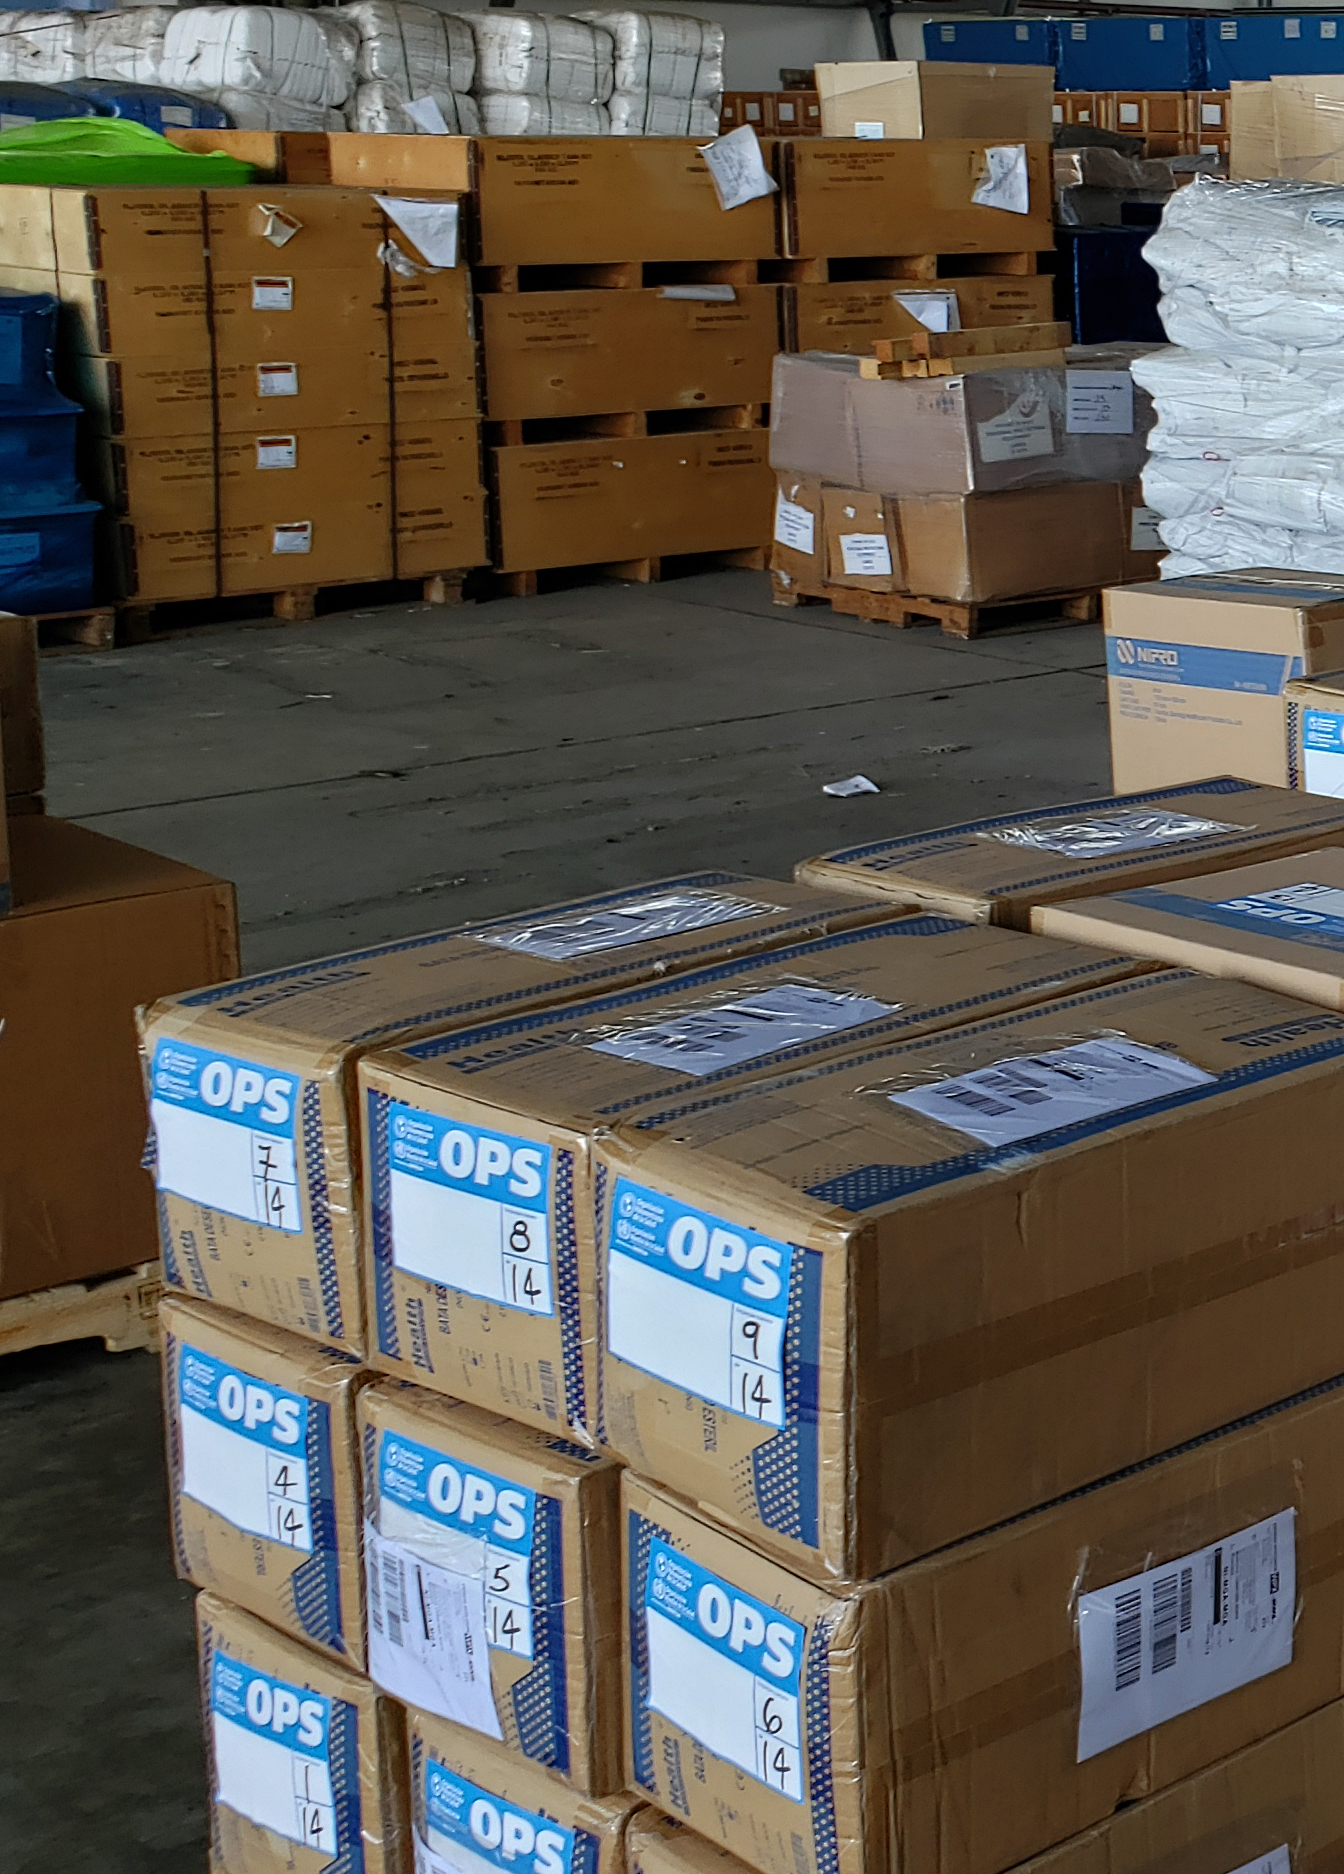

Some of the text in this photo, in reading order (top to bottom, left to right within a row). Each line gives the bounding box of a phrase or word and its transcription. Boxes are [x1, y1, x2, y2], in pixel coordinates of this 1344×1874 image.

[1217, 899, 1327, 925] OPS
[446, 1026, 584, 1072] Healt
[200, 1060, 293, 1125] OPS
[257, 1143, 278, 1181] 7
[439, 1129, 543, 1198] OPS
[263, 1182, 287, 1229] 14
[509, 1220, 531, 1252] 8
[667, 1215, 783, 1300] OPS
[179, 1230, 208, 1295] Health
[511, 1263, 542, 1306] 14
[406, 1298, 430, 1370] Health
[742, 1321, 761, 1360] 9
[218, 1374, 300, 1444] OPS
[742, 1372, 772, 1420] 14
[274, 1466, 298, 1497] 4
[427, 1463, 526, 1541] OPS
[277, 1505, 303, 1547] 14
[489, 1564, 511, 1592] 5
[493, 1606, 521, 1651] 14
[697, 1582, 796, 1678] OPS
[246, 1678, 324, 1747] OPS
[763, 1697, 783, 1734] 6
[764, 1740, 791, 1790] 14
[302, 1806, 324, 1849] 14
[469, 1797, 566, 1874] OPS
